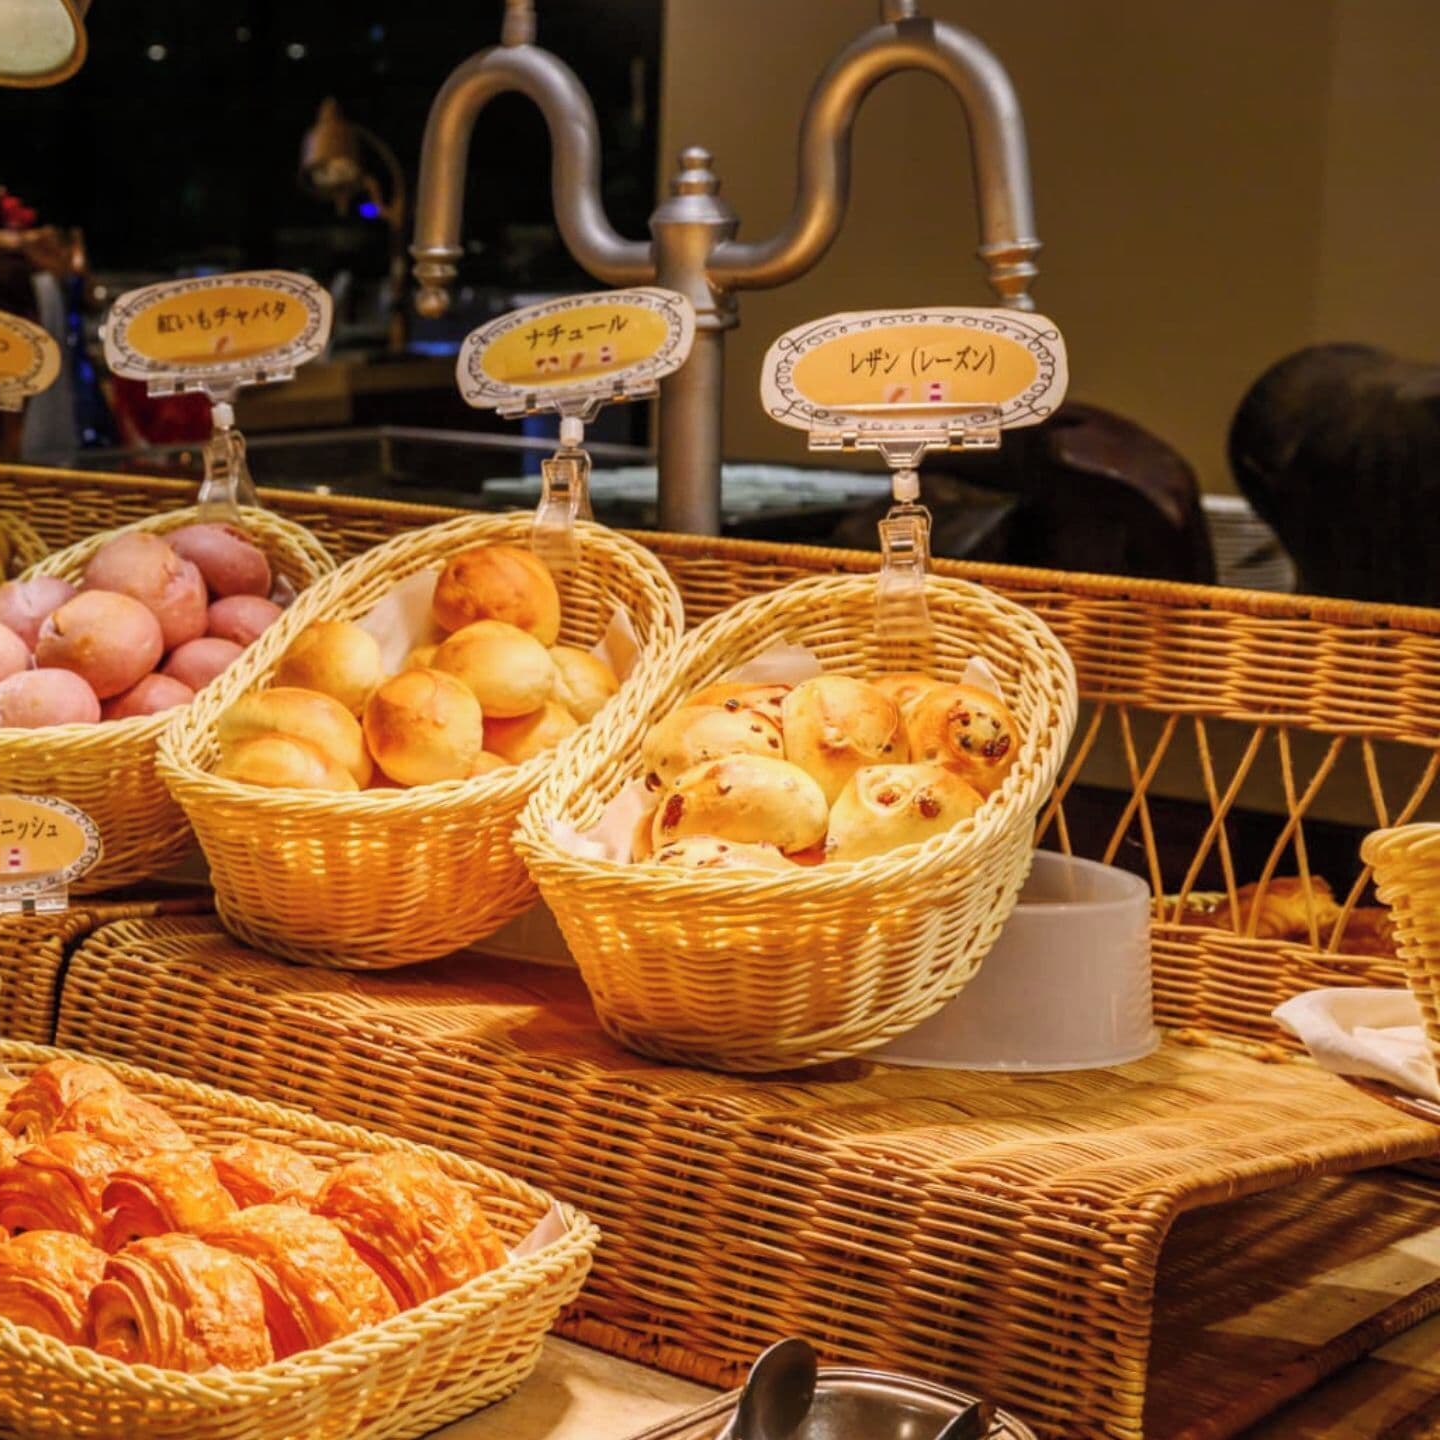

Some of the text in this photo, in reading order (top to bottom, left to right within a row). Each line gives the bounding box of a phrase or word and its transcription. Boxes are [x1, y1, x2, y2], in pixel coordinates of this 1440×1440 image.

[525, 314, 629, 350] ナチュール
